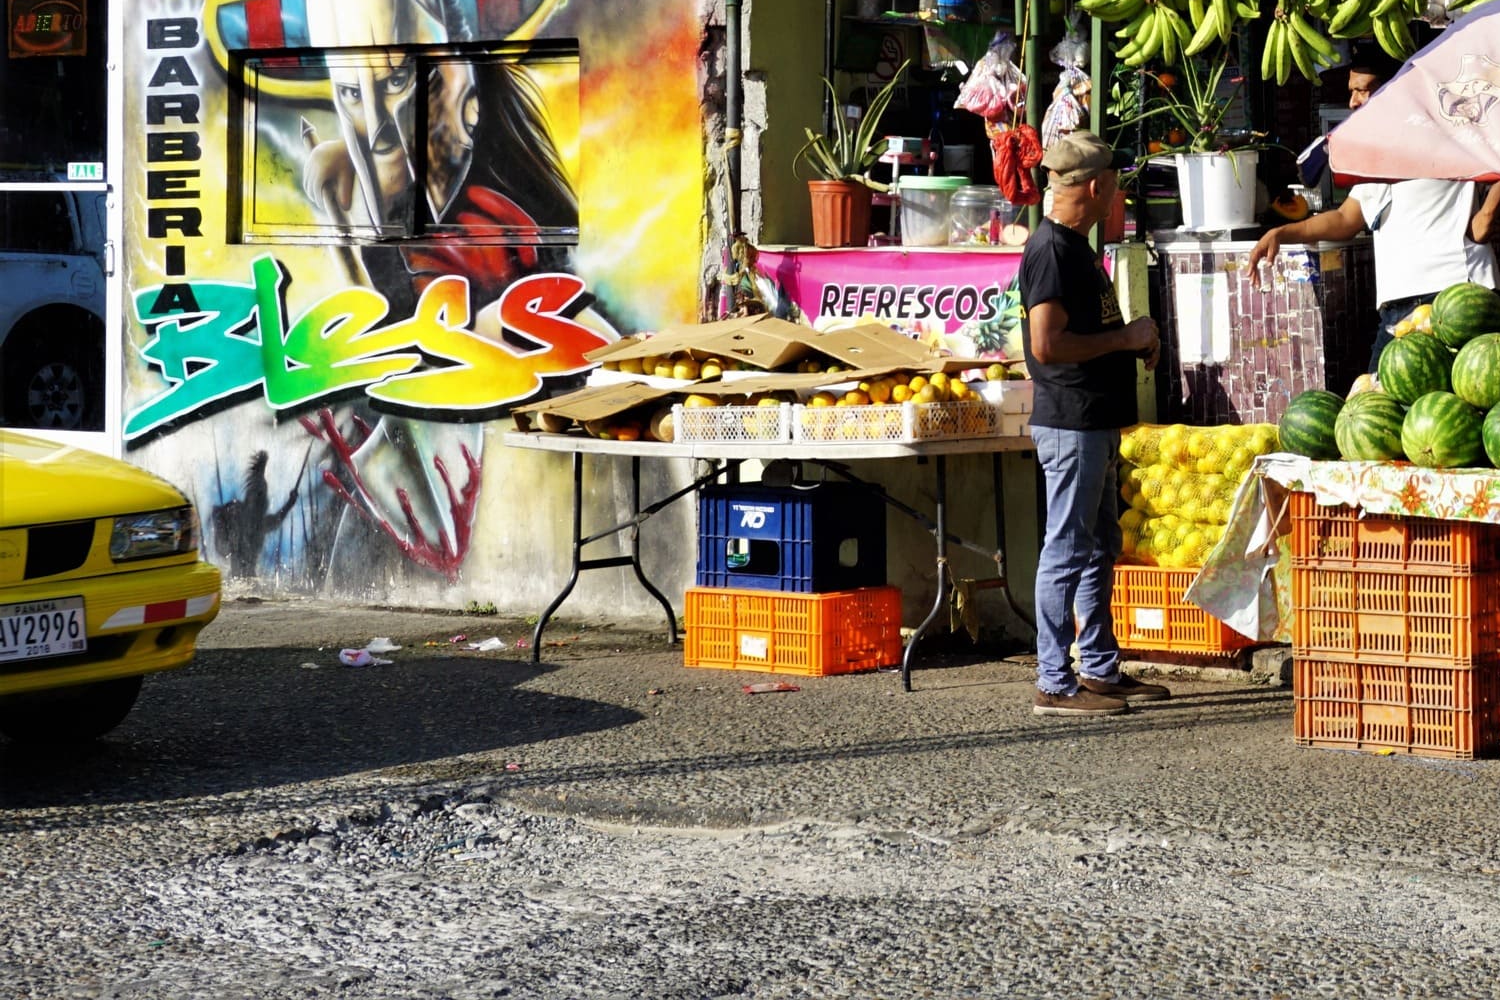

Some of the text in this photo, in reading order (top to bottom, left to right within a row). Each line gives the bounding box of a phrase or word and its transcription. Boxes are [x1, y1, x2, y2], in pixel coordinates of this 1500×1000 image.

[146, 17, 204, 316] BARBERIA
[820, 284, 1000, 322] REFRESCOS
[15, 601, 57, 614] PANAMA
